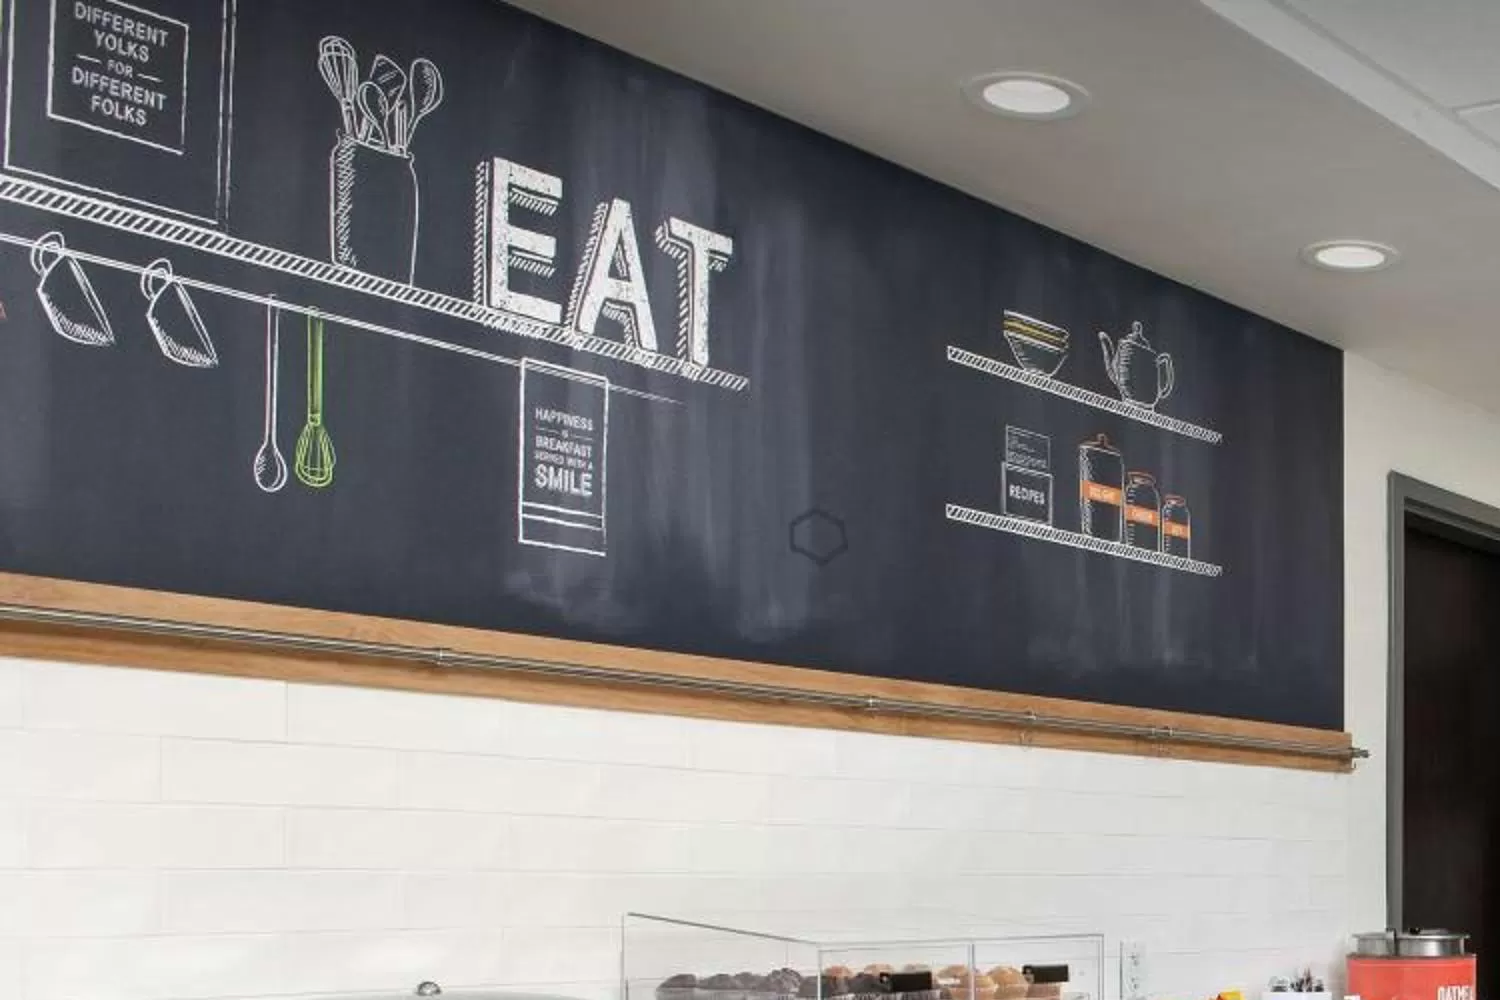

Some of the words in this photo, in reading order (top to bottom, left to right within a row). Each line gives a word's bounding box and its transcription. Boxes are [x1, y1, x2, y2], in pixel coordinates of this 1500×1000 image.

[74, 2, 168, 47] DIFFERENT
[94, 29, 149, 62] YOLKS
[107, 59, 133, 78] FOR
[72, 66, 167, 110] DIFFERENT
[91, 95, 147, 126] FOLKS
[473, 156, 733, 369] EAT
[535, 407, 593, 431] HAPPINESS
[535, 435, 592, 459] BREAKFAST
[534, 463, 593, 497] SMILE
[1009, 484, 1045, 505] RECIPES
